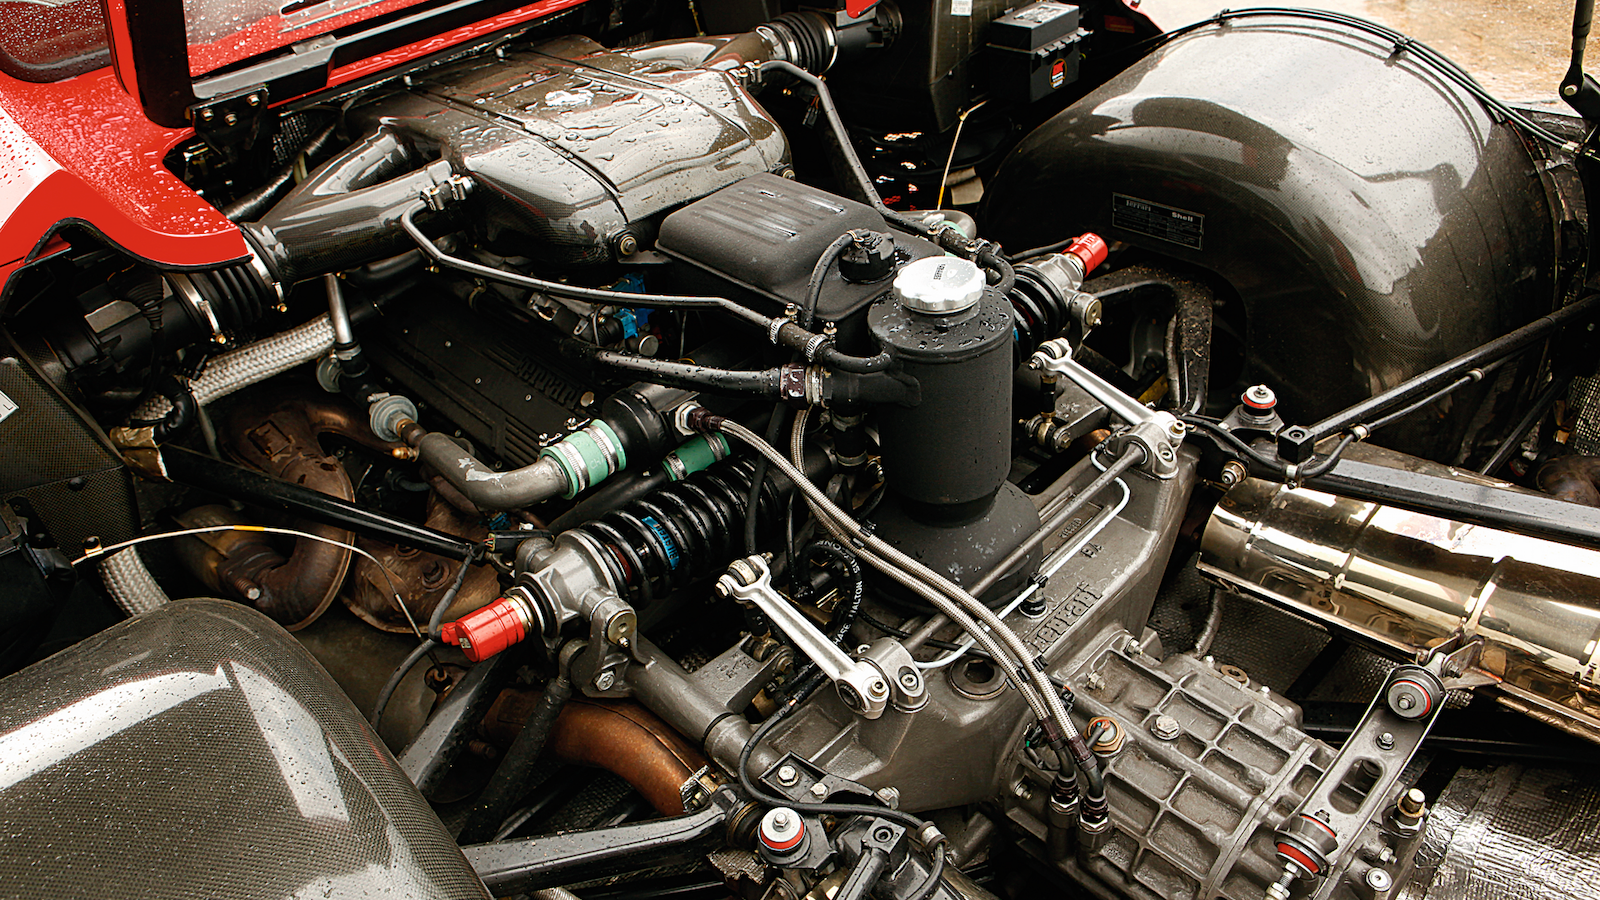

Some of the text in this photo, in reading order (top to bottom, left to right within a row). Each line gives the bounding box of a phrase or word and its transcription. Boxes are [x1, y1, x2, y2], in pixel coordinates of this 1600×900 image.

[1171, 211, 1194, 222] Shell
[1025, 581, 1103, 654] Ferrari
[833, 622, 851, 646] HASE
